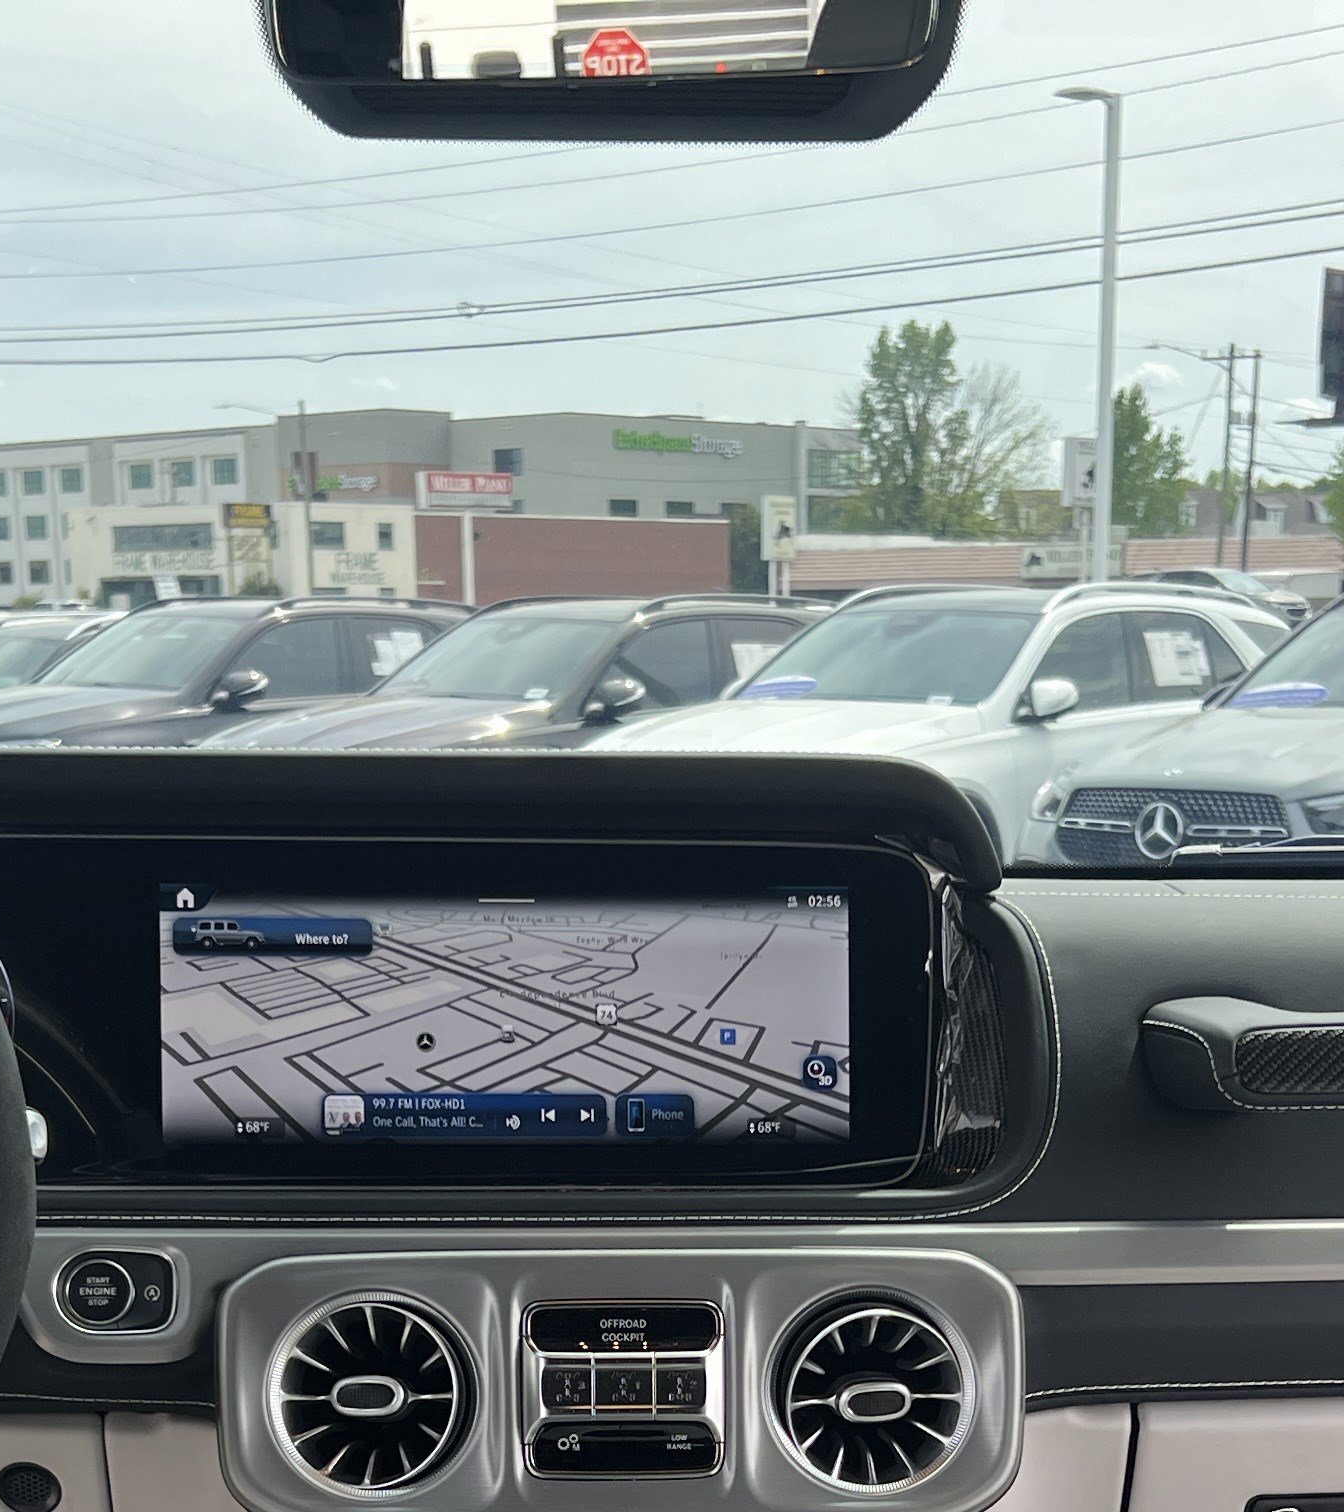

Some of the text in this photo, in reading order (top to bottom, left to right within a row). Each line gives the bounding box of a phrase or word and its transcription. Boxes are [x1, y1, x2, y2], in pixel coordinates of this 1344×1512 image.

[807, 894, 842, 908] 02:56
[295, 932, 349, 946] Where to?
[599, 1010, 614, 1021] 74
[818, 1075, 833, 1086] 3D
[372, 1098, 394, 1110] 99.7
[397, 1098, 413, 1110] FM
[421, 1098, 466, 1110] FOX-HD1
[651, 1107, 685, 1120] Phone
[245, 1121, 271, 1134] 68°F
[372, 1116, 393, 1128] One
[395, 1116, 417, 1130] Call,
[419, 1116, 449, 1128] That's
[451, 1116, 467, 1128] All!
[757, 1121, 782, 1134] 68°F
[86, 1276, 111, 1285] START
[79, 1286, 118, 1297] ENGINE
[87, 1298, 110, 1307] STOP
[599, 1318, 647, 1330] OFFROAD
[601, 1332, 645, 1343] COCKPIT
[670, 1434, 688, 1442] LOW
[666, 1442, 692, 1451] RANGE
